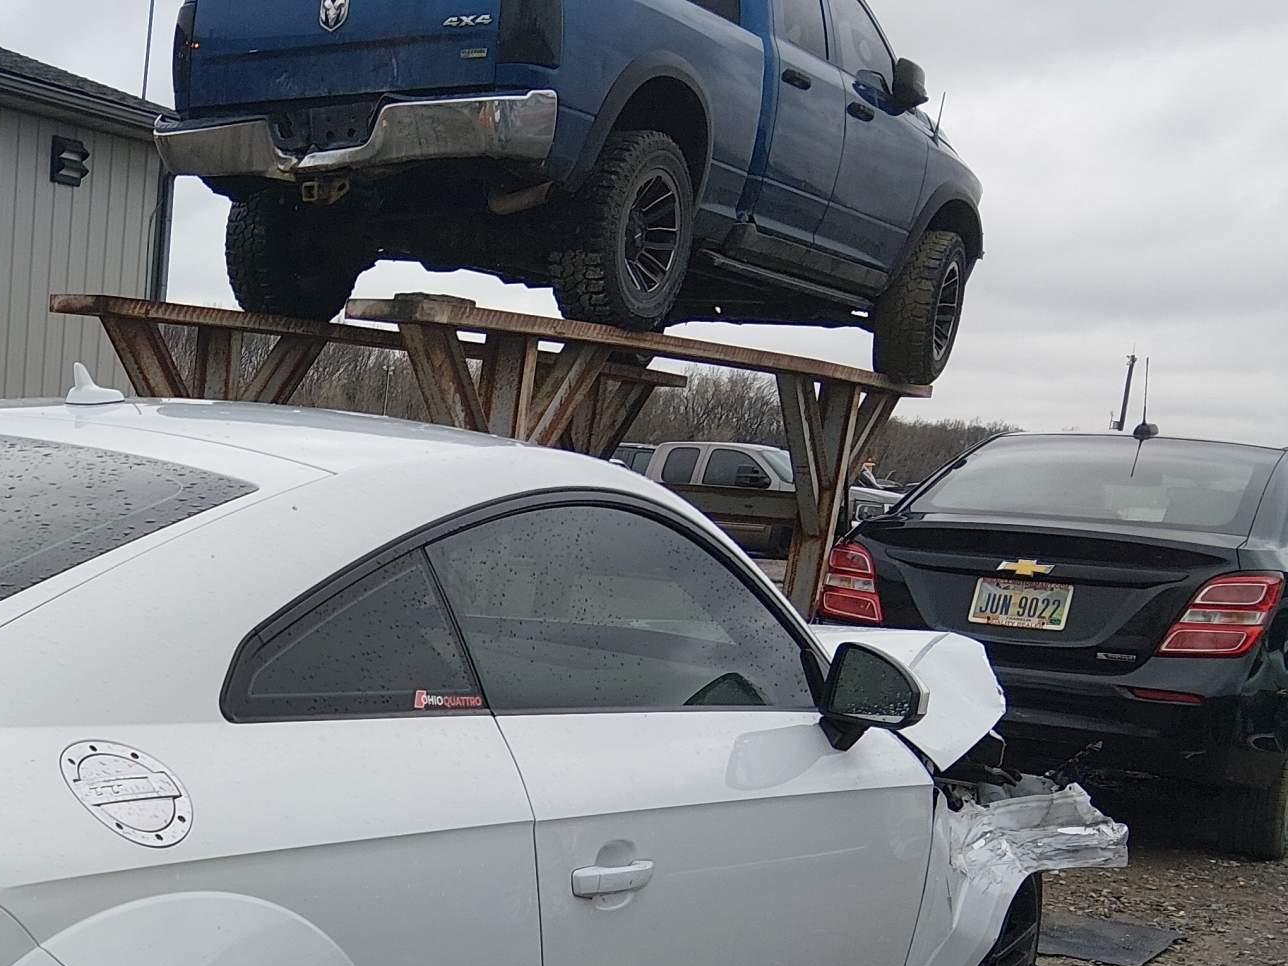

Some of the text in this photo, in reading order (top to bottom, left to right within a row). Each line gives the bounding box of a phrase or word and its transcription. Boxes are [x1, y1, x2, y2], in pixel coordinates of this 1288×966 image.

[443, 14, 492, 27] 4X4
[979, 592, 1061, 620] JUN 9022
